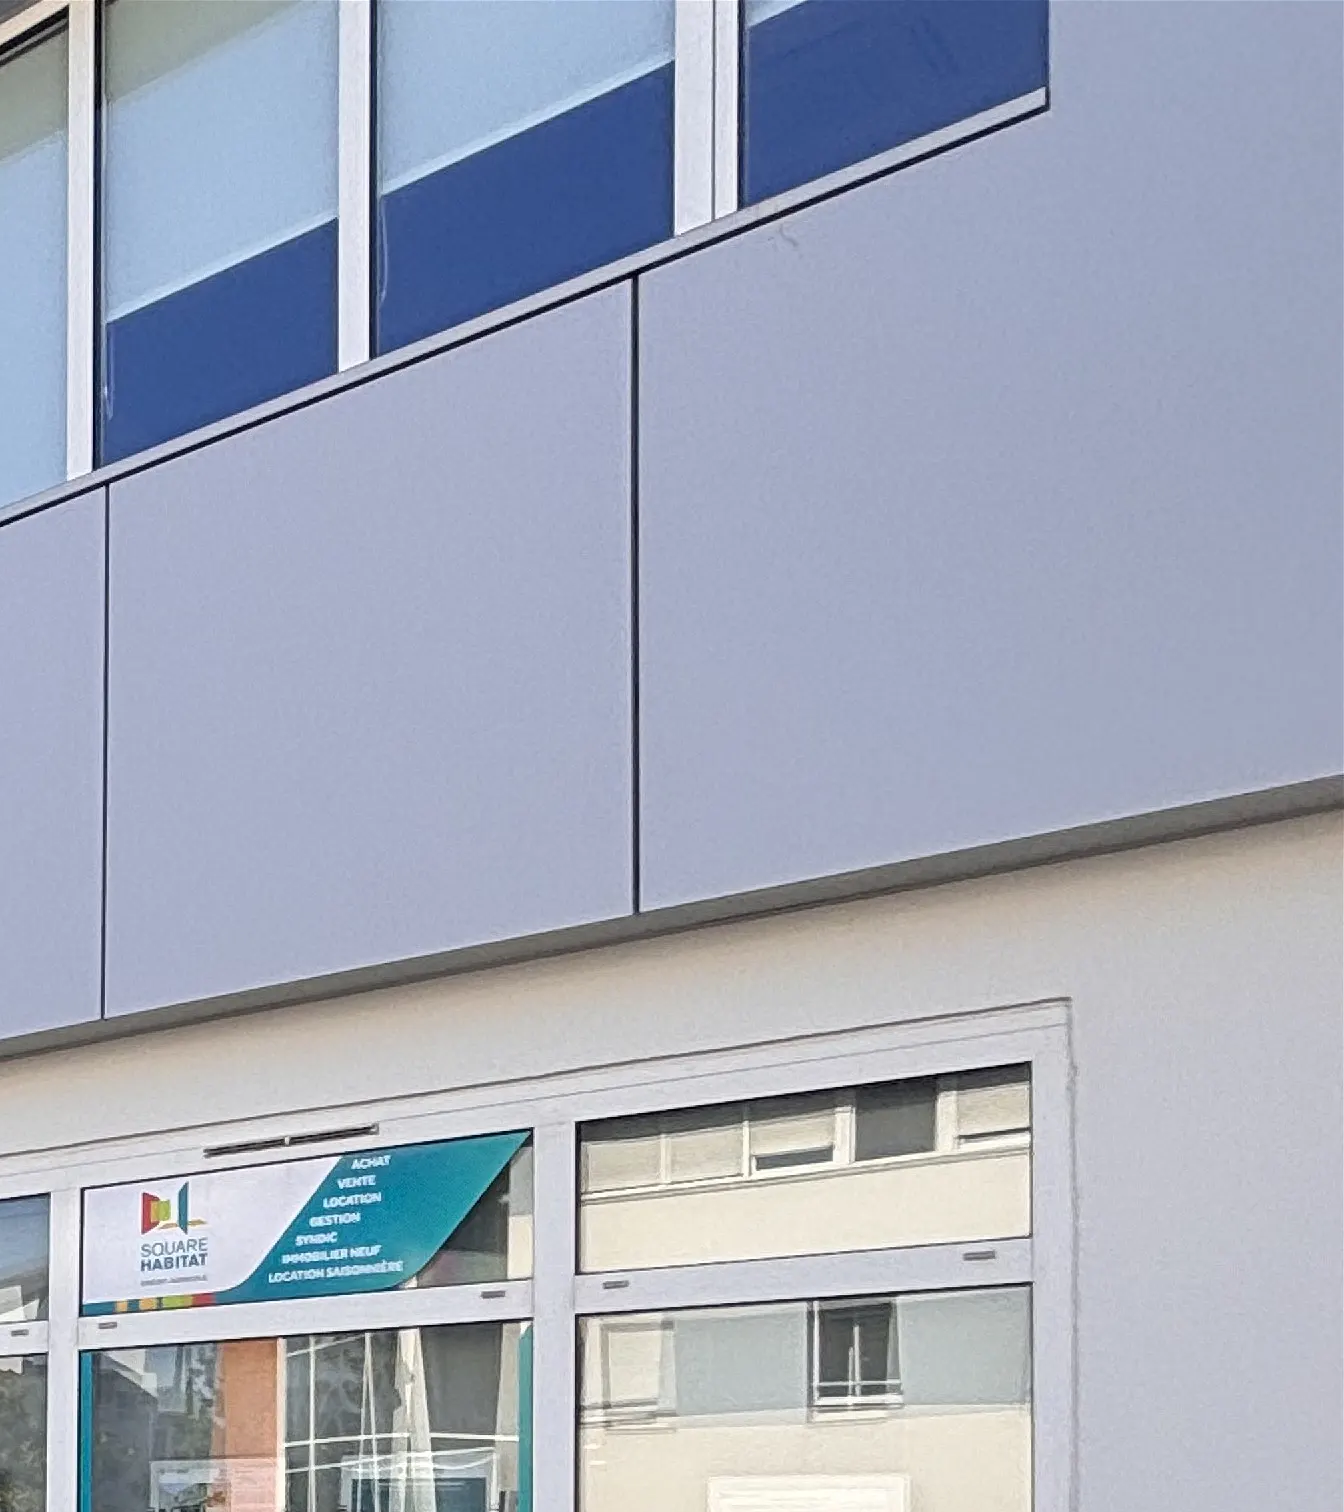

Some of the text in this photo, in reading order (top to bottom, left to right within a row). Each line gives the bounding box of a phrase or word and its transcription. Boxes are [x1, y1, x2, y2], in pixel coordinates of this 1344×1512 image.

[351, 1155, 391, 1170] ACHAT
[337, 1175, 376, 1189] VENTE
[323, 1192, 382, 1208] LOCATION
[309, 1212, 361, 1227] GESTION
[295, 1232, 338, 1246] SYNDIC
[140, 1236, 209, 1258] SQUARE
[282, 1245, 382, 1264] IMMOBILIER NEUF
[140, 1252, 209, 1272] HABITAT
[268, 1268, 325, 1283] LOCATION
